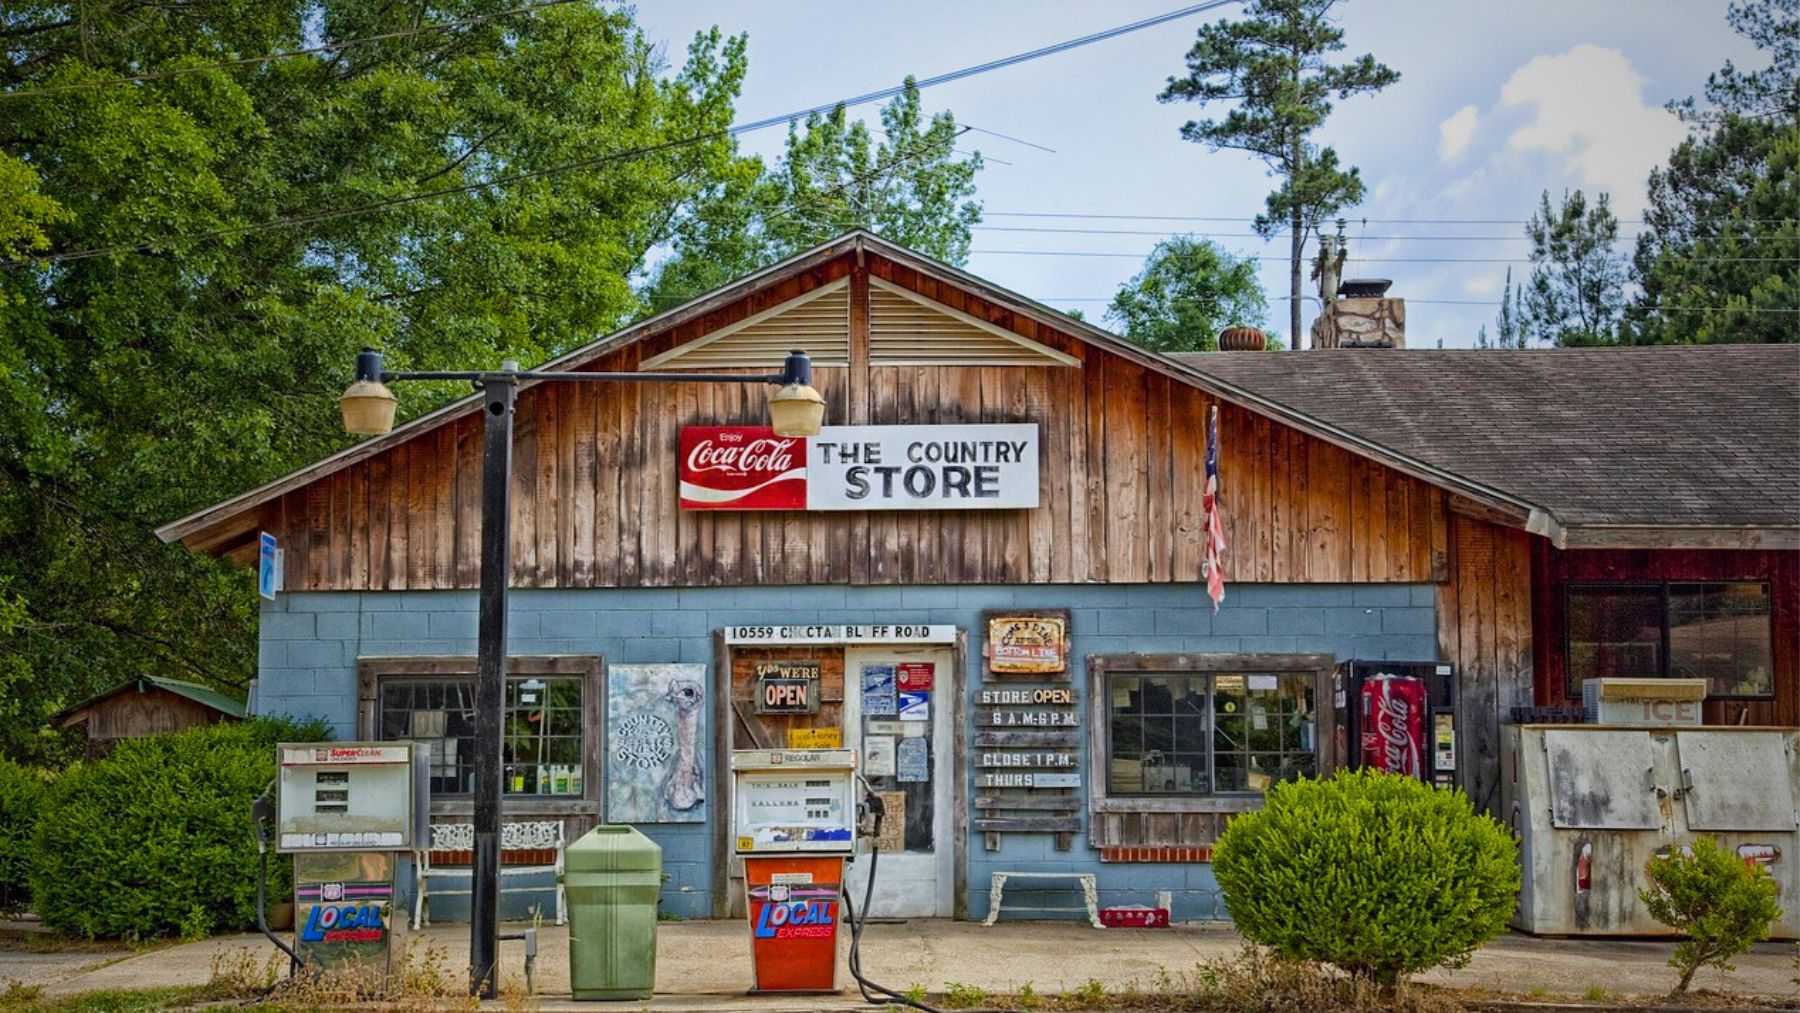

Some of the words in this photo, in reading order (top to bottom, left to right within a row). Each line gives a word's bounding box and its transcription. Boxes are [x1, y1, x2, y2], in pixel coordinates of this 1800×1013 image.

[720, 432, 743, 442] Enjoy
[687, 439, 798, 472] Coca-Cola
[816, 442, 882, 465] THE
[907, 441, 1028, 464] COUNTRY
[845, 465, 1000, 499] STORE
[733, 626, 774, 639] 10559
[846, 625, 889, 638] BLFF
[895, 625, 929, 638] ROAD
[765, 684, 807, 706] OPEN
[983, 691, 1029, 704] STORE
[1034, 689, 1070, 703] OPEN
[1643, 699, 1695, 721] ICE
[983, 753, 1030, 766] CLOSE
[1046, 753, 1074, 766] P.M.
[985, 773, 1033, 786] THURS
[303, 904, 384, 942] LOCAL
[755, 901, 833, 939] LOCAL
[777, 926, 833, 938] EXPRESS
